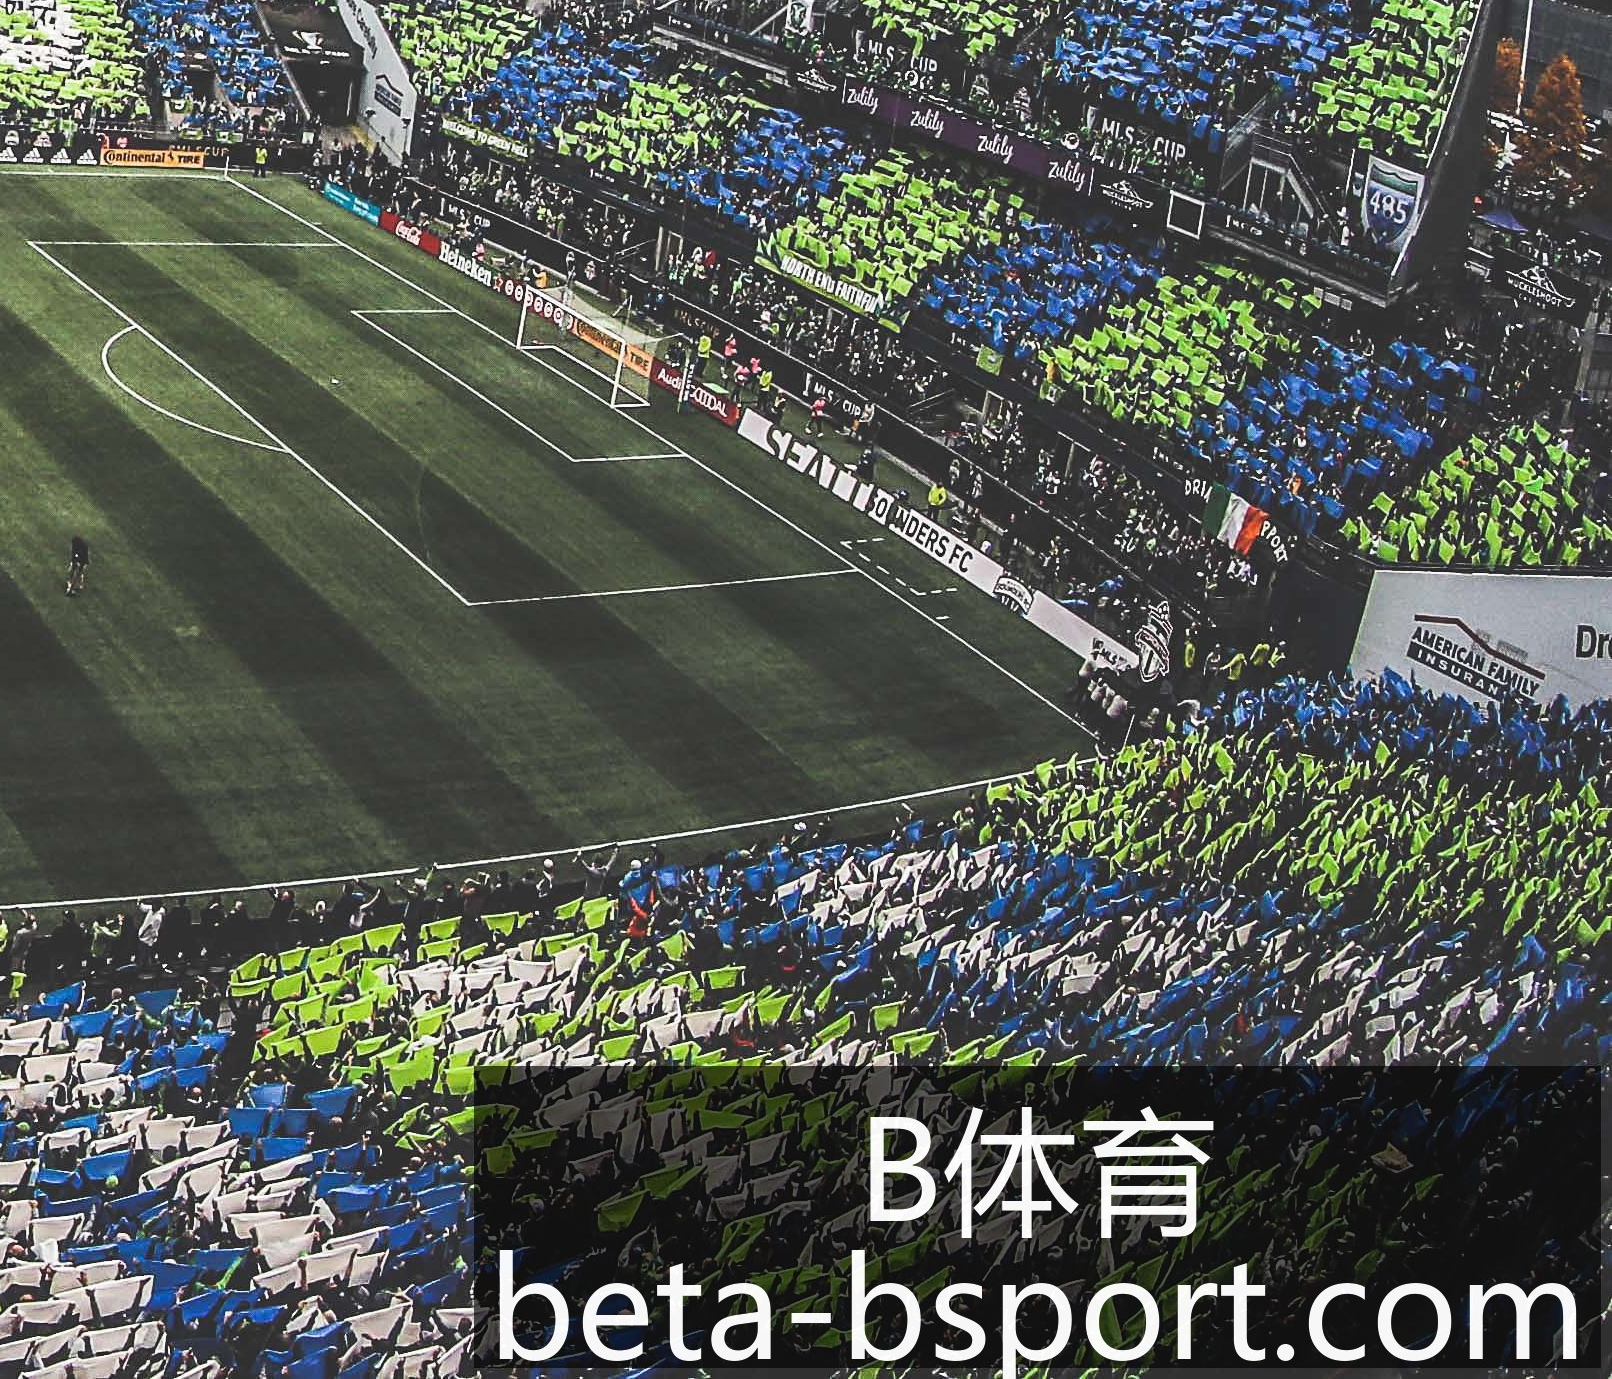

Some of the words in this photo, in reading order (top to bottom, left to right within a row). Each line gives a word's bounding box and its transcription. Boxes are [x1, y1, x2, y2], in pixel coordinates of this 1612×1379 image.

[103, 150, 166, 164] Continental
[178, 155, 202, 164] TIRE
[1369, 190, 1408, 224] 485
[439, 240, 492, 287] Heineken
[1507, 277, 1563, 308] MUCKLESHOOT
[657, 368, 685, 392] Audi
[949, 550, 974, 573] FC
[1411, 626, 1485, 671] AMERICAN
[1488, 659, 1540, 697] FAMILY
